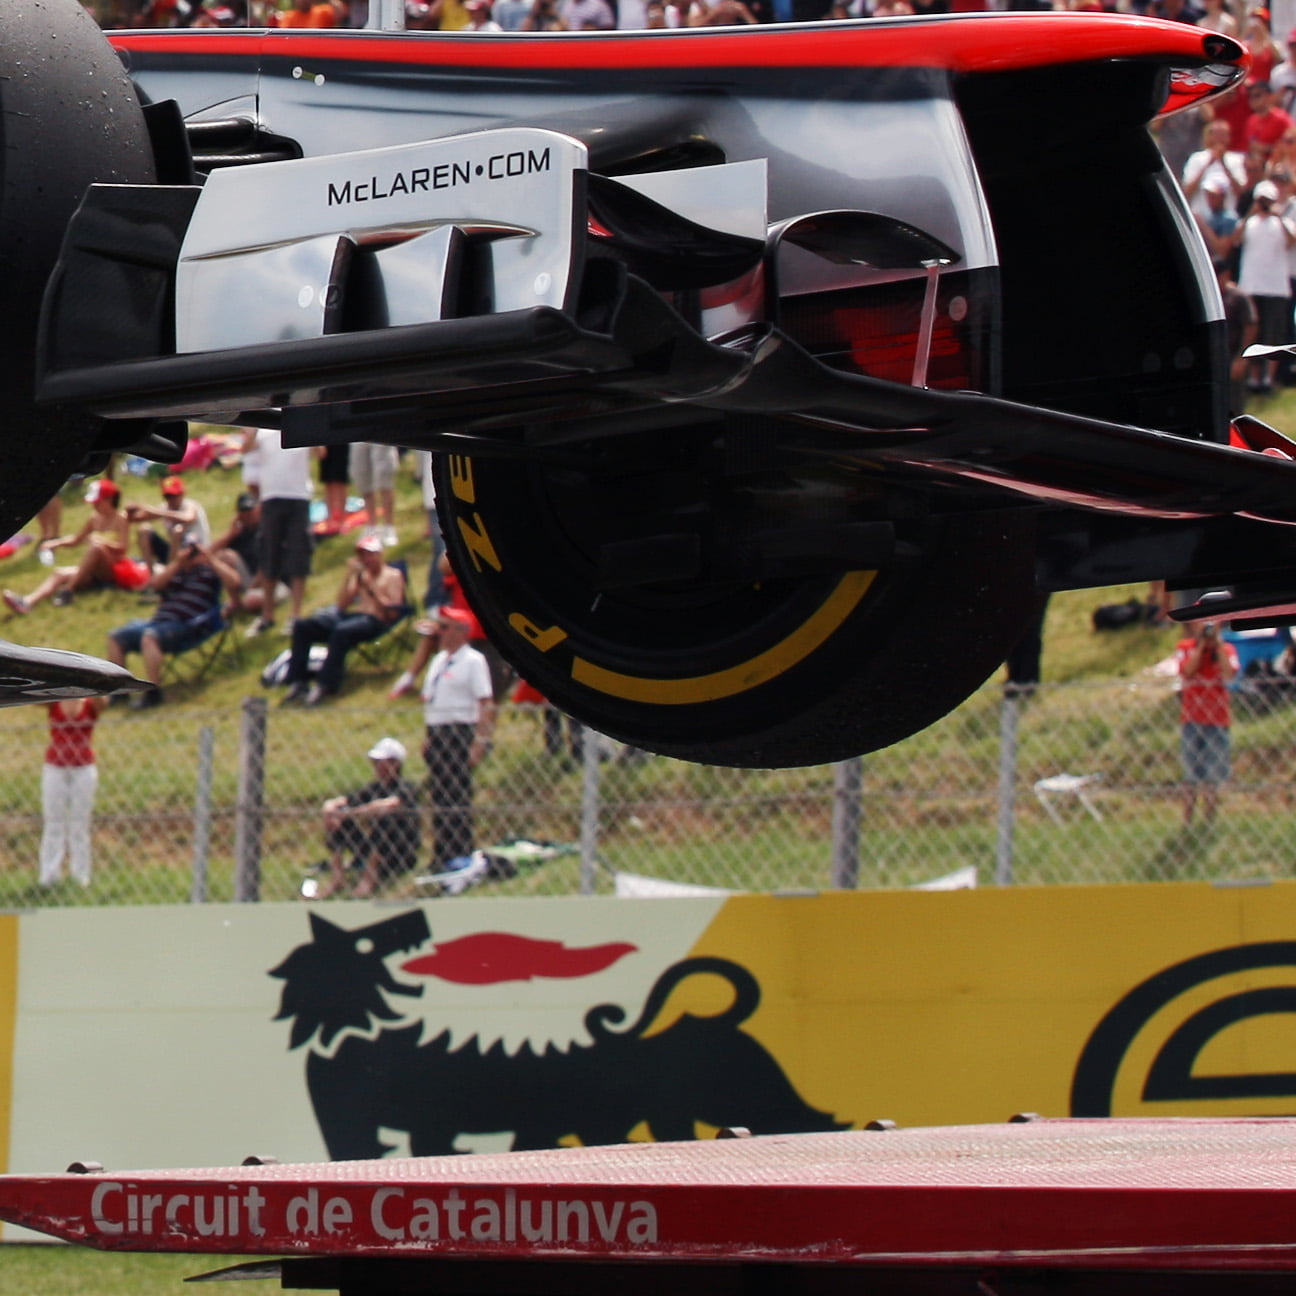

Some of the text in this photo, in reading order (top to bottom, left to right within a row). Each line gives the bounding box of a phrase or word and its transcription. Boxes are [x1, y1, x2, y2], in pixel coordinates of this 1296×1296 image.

[449, 454, 568, 653] P ZE
[90, 1181, 266, 1237] Circuit
[286, 1186, 354, 1237] de
